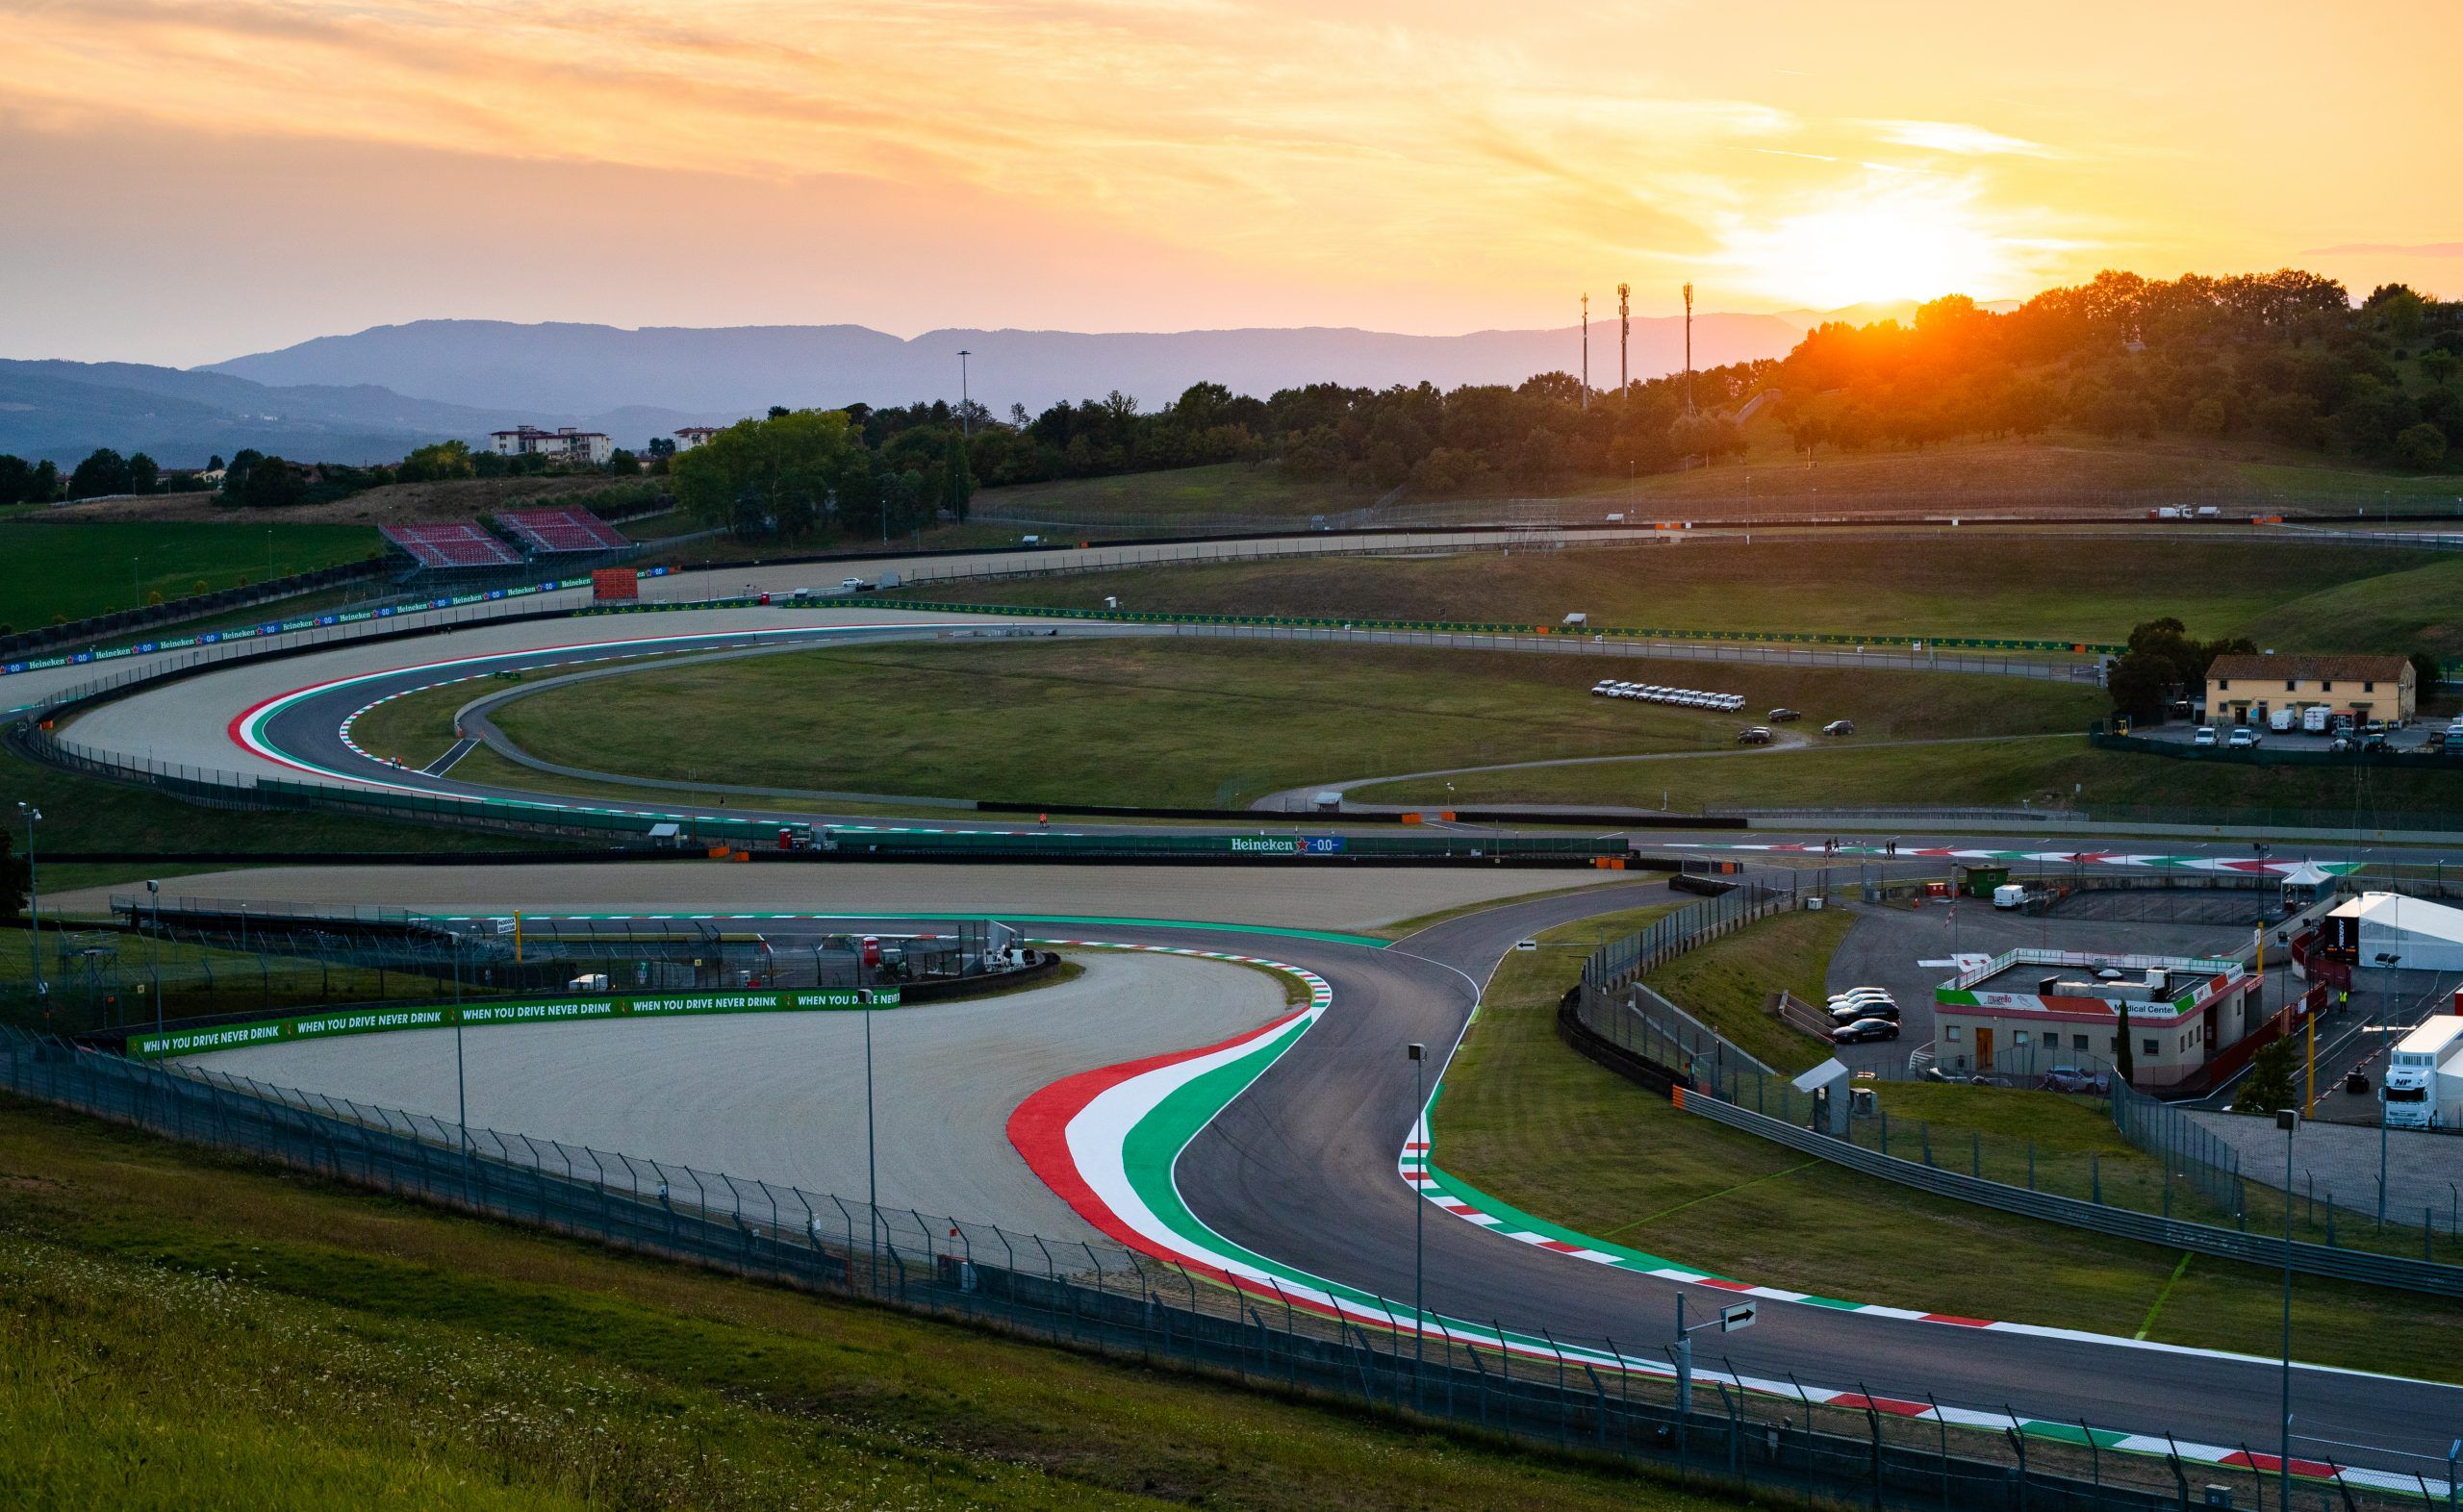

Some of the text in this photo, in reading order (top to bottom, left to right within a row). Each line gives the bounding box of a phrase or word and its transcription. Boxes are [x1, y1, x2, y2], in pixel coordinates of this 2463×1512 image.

[30, 659, 65, 668] Heineken
[96, 648, 131, 659] Heineken
[161, 639, 194, 649] Heineken
[223, 629, 255, 640] Heineken
[340, 612, 370, 621] Heineken
[397, 603, 427, 613] Heineken
[453, 594, 482, 604] Heineken
[508, 587, 536, 595] Heineken
[562, 578, 591, 587] Heineken
[1232, 839, 1293, 850] Heineken
[633, 1001, 661, 1011] WHEN
[664, 1000, 684, 1010] YOU
[686, 998, 713, 1009] DRIVE
[715, 997, 745, 1007] NEVER
[748, 996, 776, 1007] DRINK
[798, 995, 825, 1005] WHEN
[828, 995, 850, 1005] YOU
[1988, 995, 2012, 1003] mugello
[463, 1002, 612, 1020] WHEN YOU DRIVE NEVER DRINK
[2114, 1004, 2146, 1013] Mdical
[297, 1011, 442, 1033] WHEN YOU DRIVE NEVER DRINK
[172, 1036, 190, 1048] YOU
[192, 1032, 219, 1046] DRIVE
[220, 1029, 249, 1044] NEVER
[250, 1025, 279, 1040] DRINK
